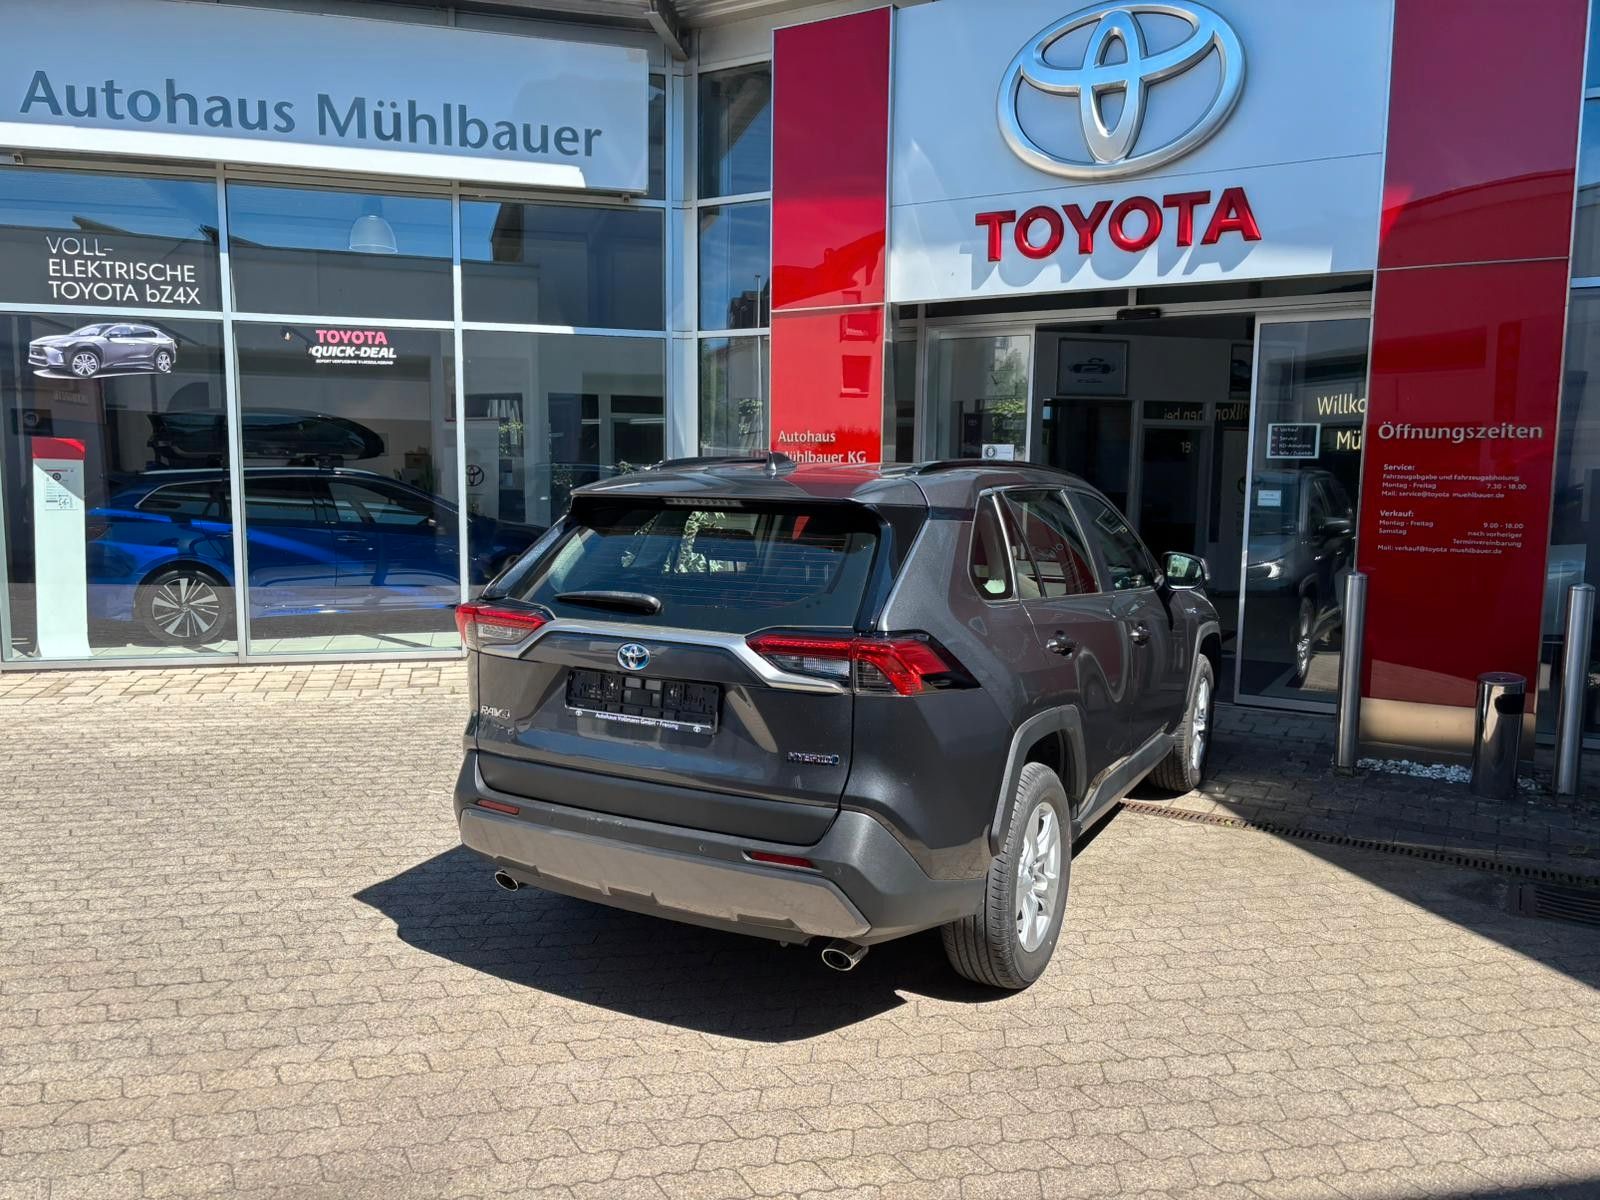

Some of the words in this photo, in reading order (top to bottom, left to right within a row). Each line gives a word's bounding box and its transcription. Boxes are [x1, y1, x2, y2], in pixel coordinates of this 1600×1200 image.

[20, 70, 295, 133] Autohaus
[317, 93, 603, 158] Mühlbauer
[975, 187, 1262, 263] TOYOTA
[46, 236, 113, 256] VOLL-
[48, 258, 196, 282] ELEKTRISCHE
[48, 281, 139, 301] TOYOTA
[145, 284, 201, 304] bZ4X
[315, 329, 388, 345] TOYOTA
[310, 345, 397, 358] QUICK-DEAL
[778, 430, 836, 442] Autohaus
[1378, 421, 1543, 443] Öffnungszeiten
[784, 451, 844, 463] ühlbauer
[848, 451, 866, 463] KG
[1383, 463, 1415, 471] Service:
[1381, 481, 1407, 489] Montag
[1413, 481, 1436, 489] Freitag
[1379, 509, 1413, 518] Verkauf:
[1378, 519, 1404, 527] Montag
[1409, 520, 1433, 528] Freitag
[1378, 528, 1407, 536] Samstag
